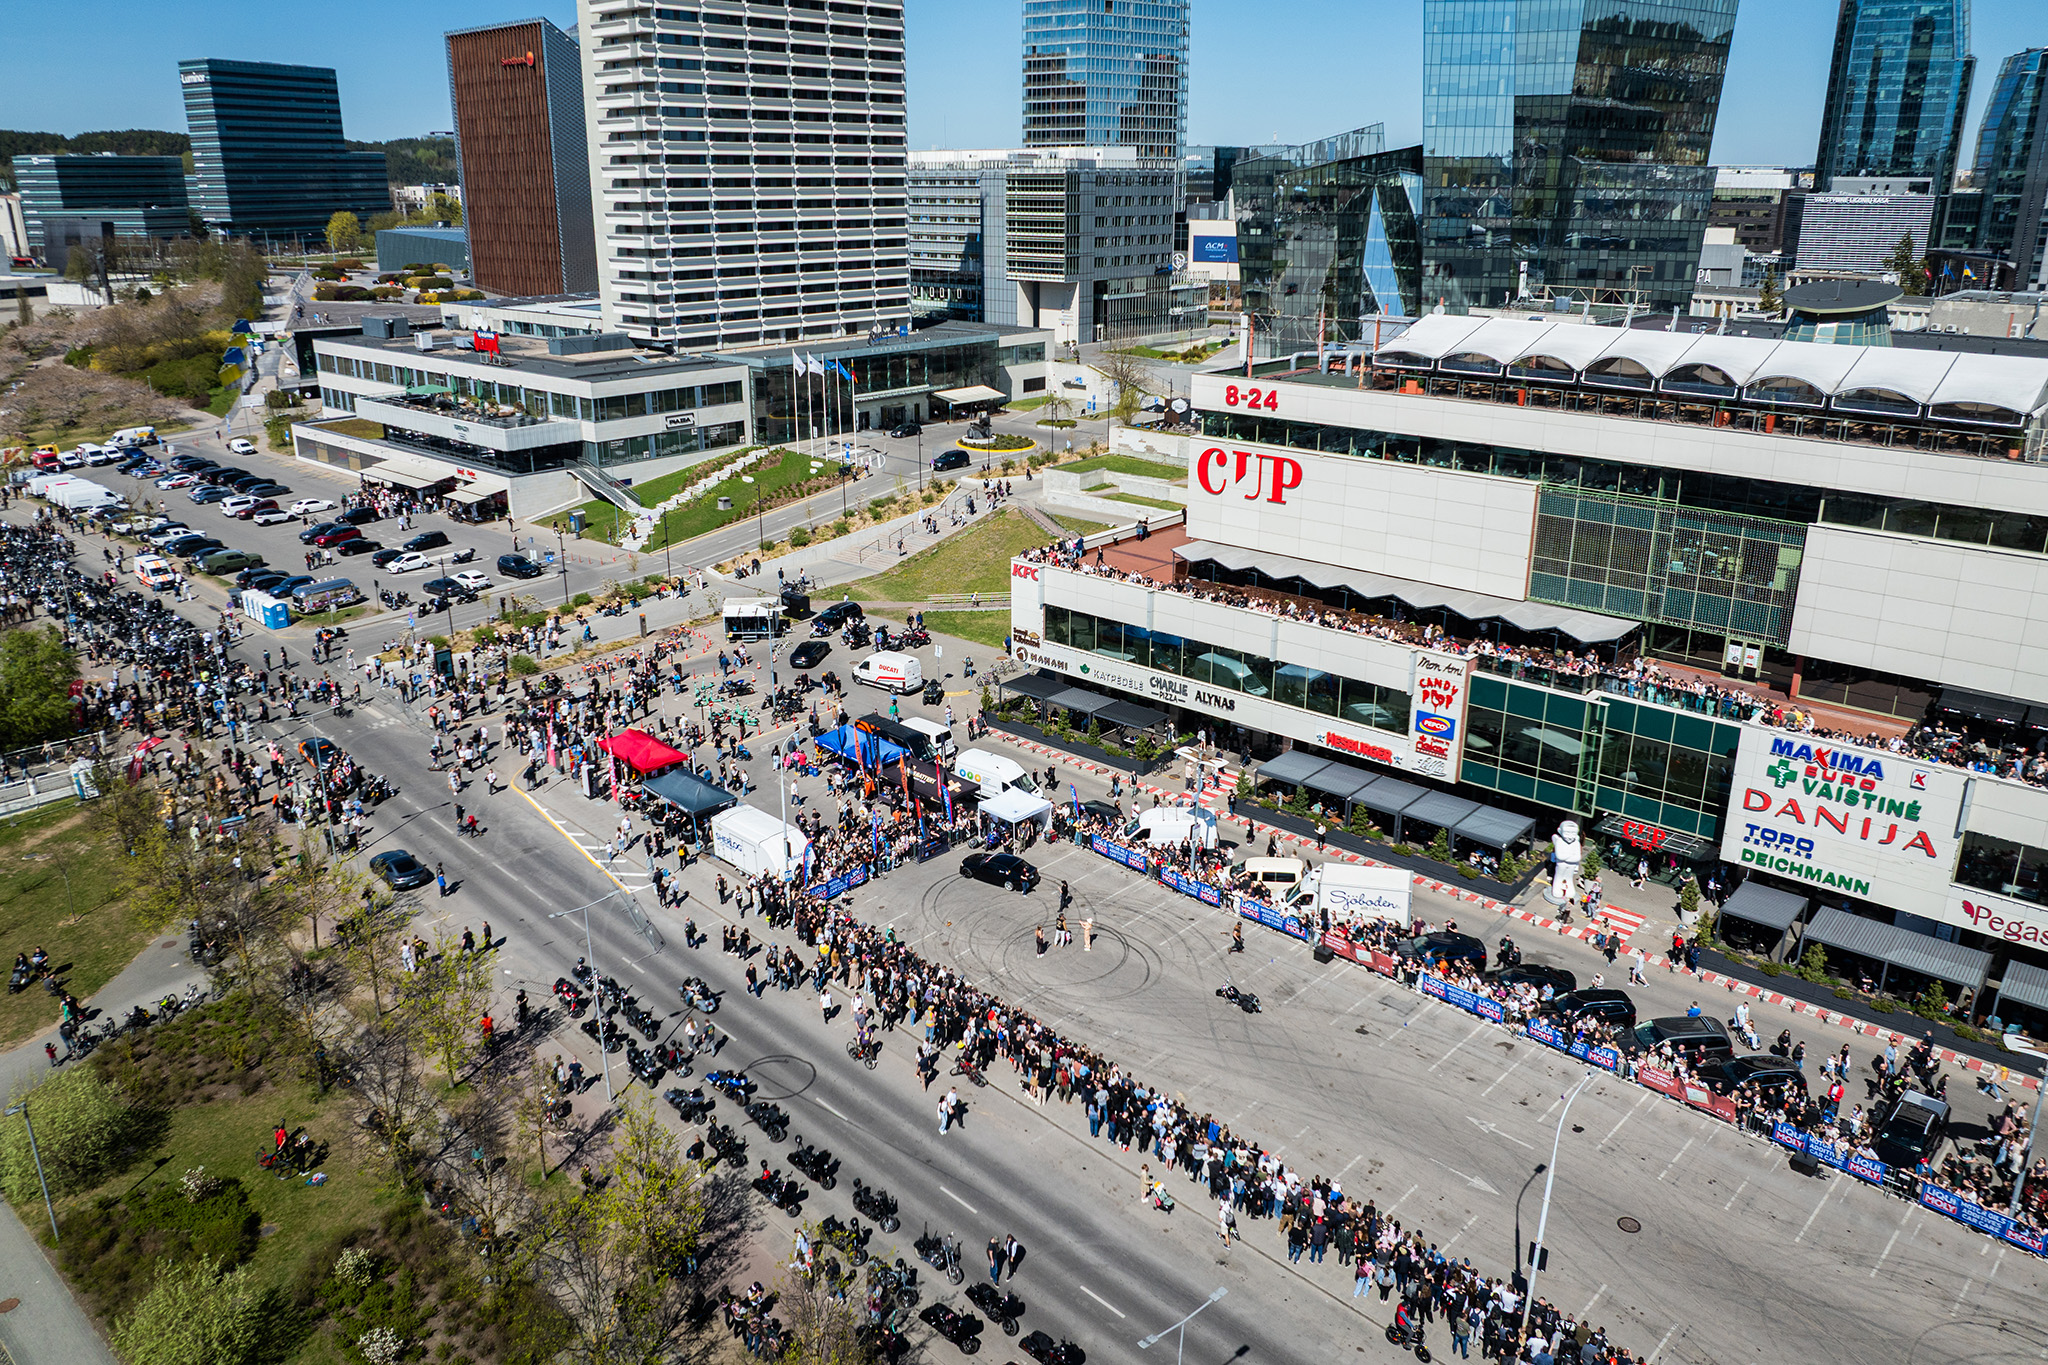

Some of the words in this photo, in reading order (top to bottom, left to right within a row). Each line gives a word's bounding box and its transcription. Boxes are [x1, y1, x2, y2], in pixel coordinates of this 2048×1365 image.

[180, 72, 206, 84] Luminor
[1205, 242, 1225, 250] ACM
[1225, 385, 1279, 412] 8-24
[1197, 447, 1304, 504] CUP
[1012, 563, 1039, 581] KFC
[878, 664, 899, 674] DUCATI
[1149, 676, 1188, 697] CHARLIE
[1419, 677, 1459, 696] CANDY
[1159, 692, 1178, 704] PIZZA
[1194, 690, 1236, 711] ALYNAS
[1423, 719, 1448, 732] PEPCO
[1326, 731, 1393, 765] HESBURGER
[1769, 737, 1885, 781] MAXIMA
[1804, 765, 1876, 792] EURO
[1802, 778, 1922, 822] VAISTINĖ
[1743, 787, 1937, 858] DANIJA
[1622, 821, 1667, 845] CUP
[1745, 823, 1815, 852] TOPO
[1743, 836, 1813, 860] CENTRAS
[1741, 848, 1870, 896] DEICHMANN
[1200, 891, 1219, 904] MOLY
[1330, 890, 1400, 911] Sjöboden
[1240, 907, 1260, 919] MOLY
[1423, 983, 1445, 997] MOLY
[1478, 999, 1500, 1013] LIQUI
[1478, 1005, 1501, 1020] MOLY
[1530, 1027, 1553, 1043] MOLY
[1588, 1051, 1614, 1068] MOLY
[1775, 1130, 1805, 1149] MOLY
[1777, 1123, 1805, 1140] LIQUI
[1809, 1148, 1823, 1159] CAR
[1848, 1162, 1881, 1181] MOLY
[1851, 1154, 1881, 1173] LIQUI
[1924, 1193, 1957, 1214] MOLY
[1926, 1186, 1957, 1205] LIQUI
[1960, 1200, 1987, 1217] MOTOR
[1988, 1212, 2007, 1225] OILS
[1961, 1208, 2003, 1229] ADDITIVES
[1961, 1213, 1978, 1225] CAR
[1980, 1219, 2000, 1234] CARE
[2006, 1228, 2044, 1251] MOLY
